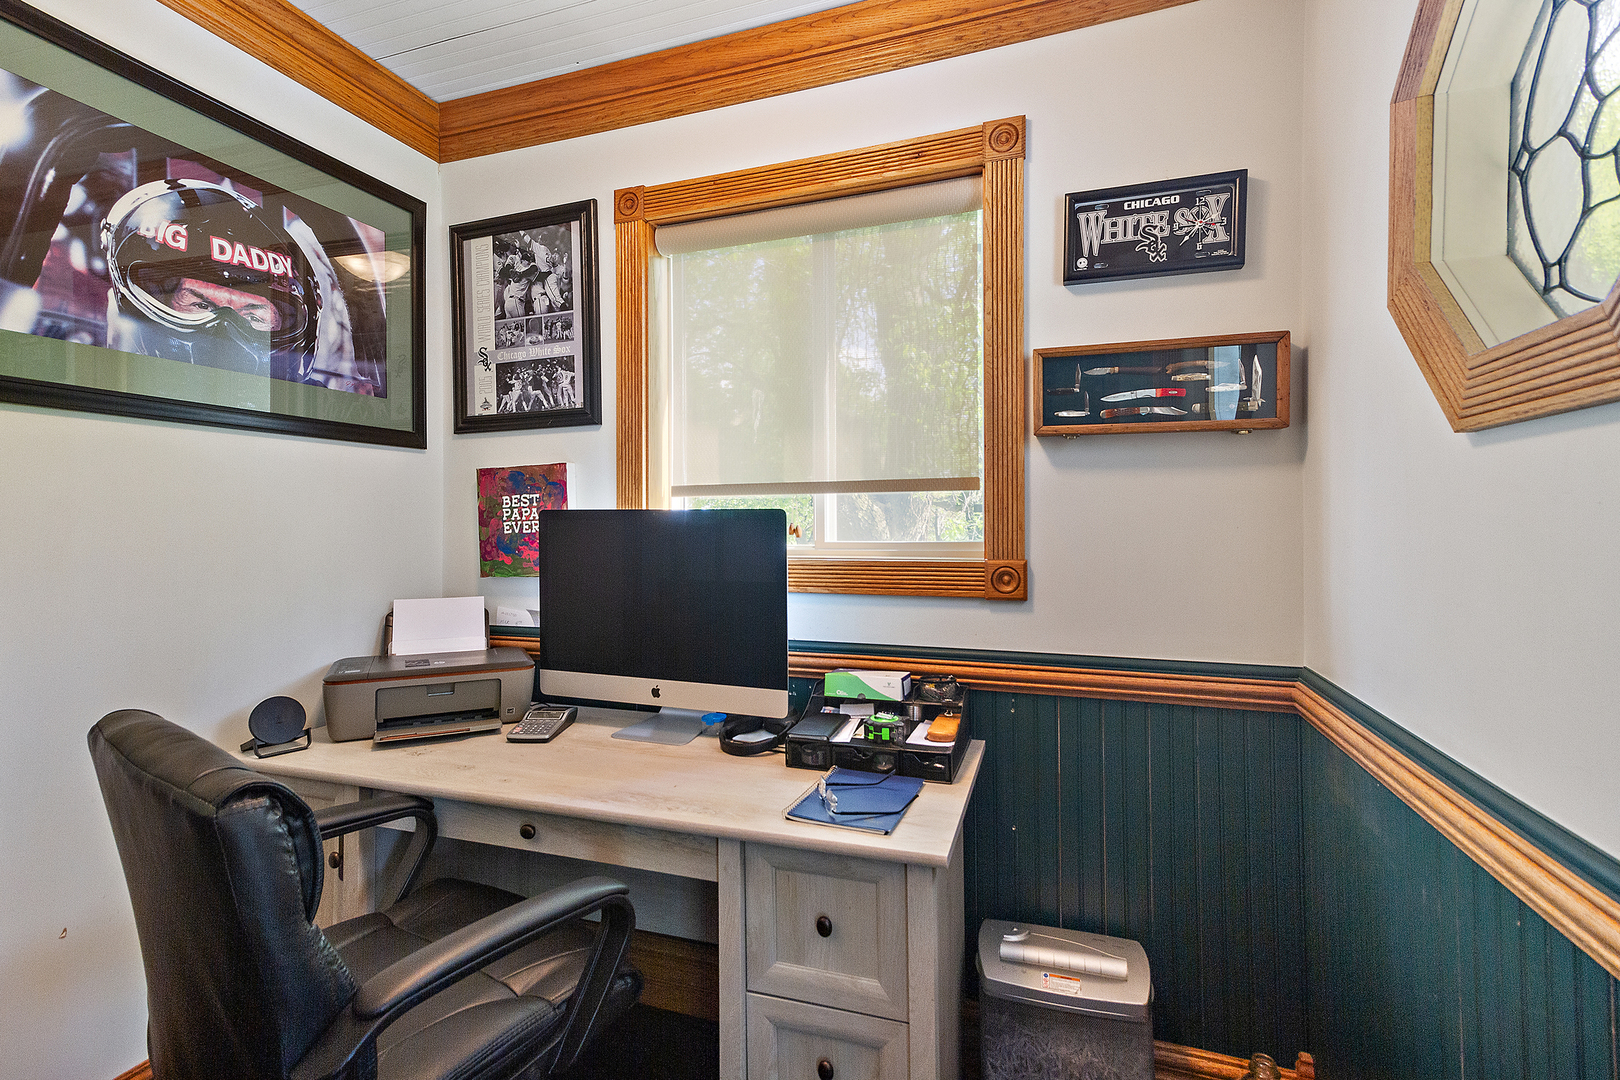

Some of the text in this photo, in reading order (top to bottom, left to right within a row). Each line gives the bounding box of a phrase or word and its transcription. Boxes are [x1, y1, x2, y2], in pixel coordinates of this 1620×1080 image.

[1124, 195, 1180, 210] CHICAGO
[1195, 196, 1206, 206] 12
[1173, 222, 1179, 231] 9
[1221, 216, 1227, 226] 3
[1077, 209, 1170, 257] WHITE
[1196, 242, 1203, 251] 6
[209, 235, 293, 279] DADDY
[475, 243, 490, 287] CHAMPIONS
[476, 288, 491, 313] SERIES
[476, 315, 492, 344] WORLD
[497, 344, 571, 361] Chicago White Sox
[503, 494, 540, 507] BEST
[503, 508, 540, 520] PAPA
[504, 521, 540, 533] EVER
